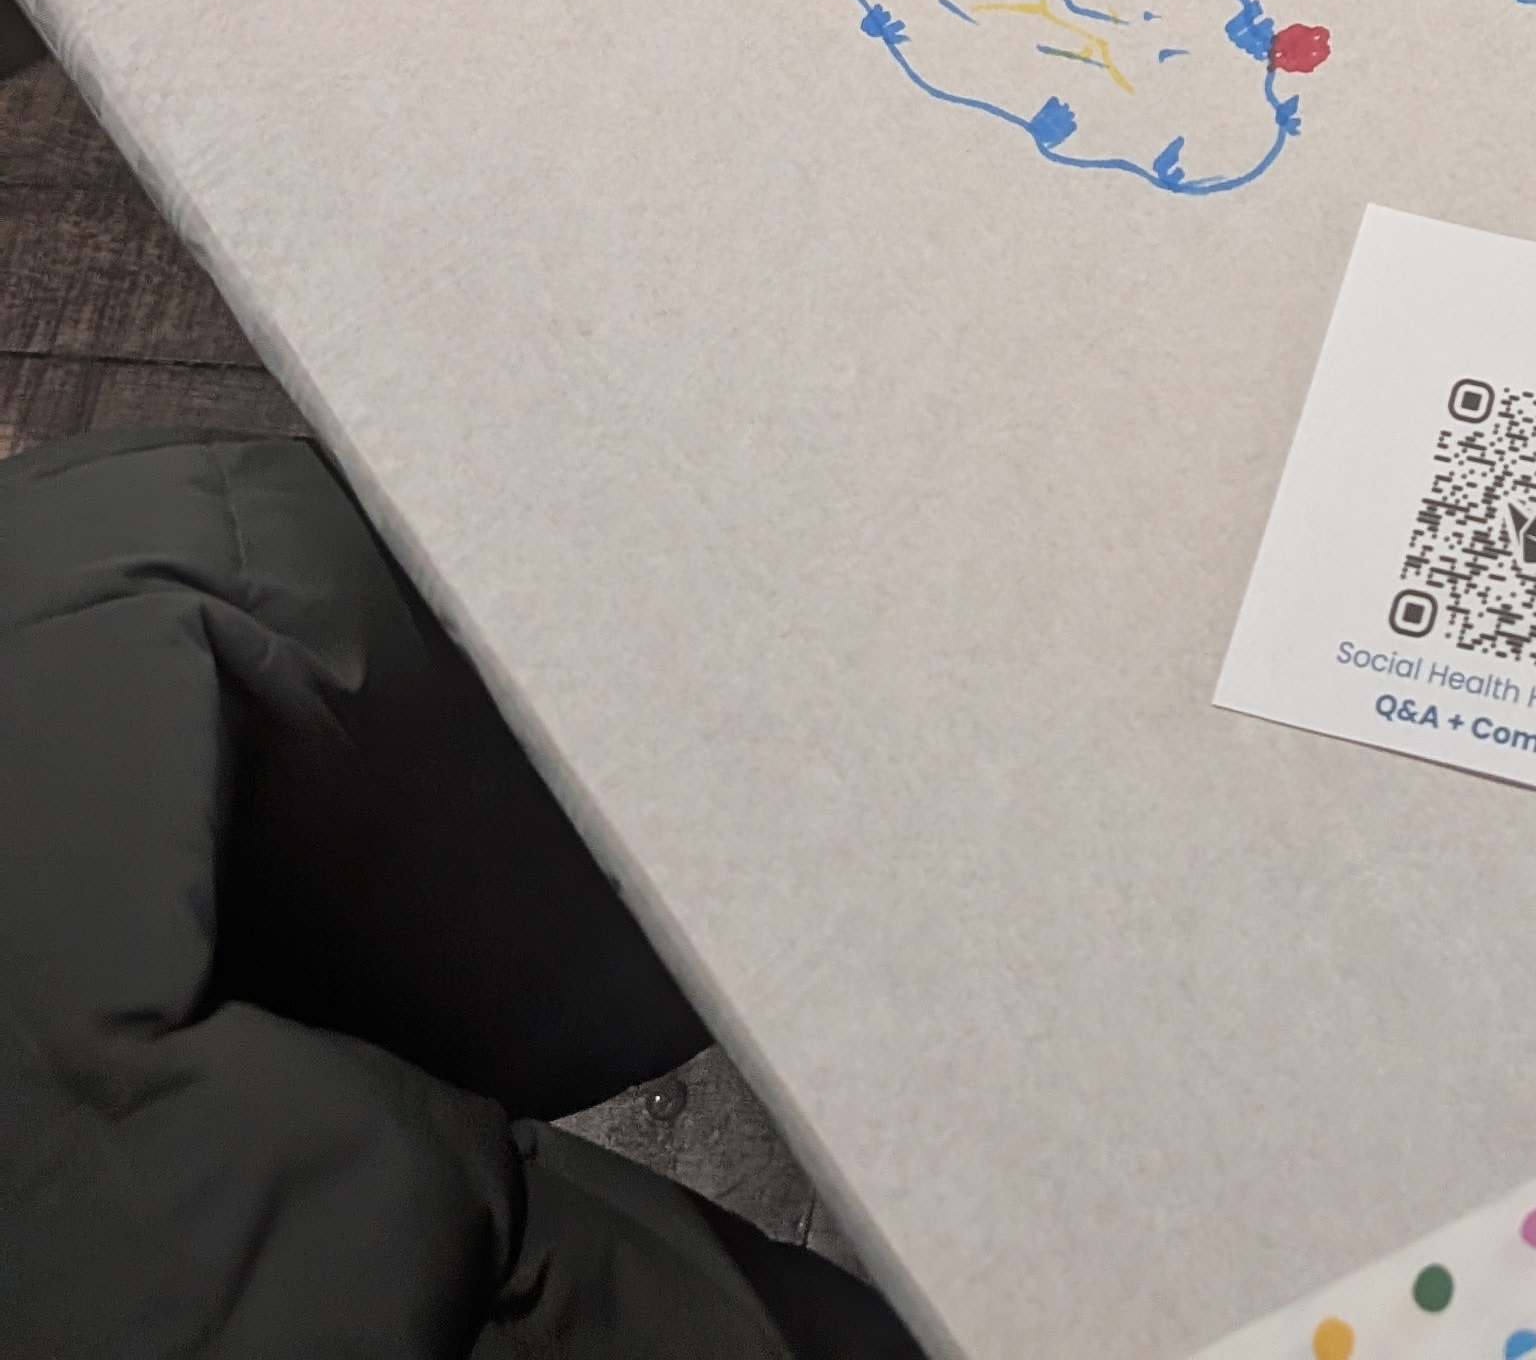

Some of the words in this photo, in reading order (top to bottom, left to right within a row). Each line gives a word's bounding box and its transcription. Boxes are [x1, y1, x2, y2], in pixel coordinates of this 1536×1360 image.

[1336, 640, 1423, 681] Social
[1428, 665, 1520, 705] Health
[1375, 693, 1439, 729] Q&A
[1448, 715, 1465, 731] +
